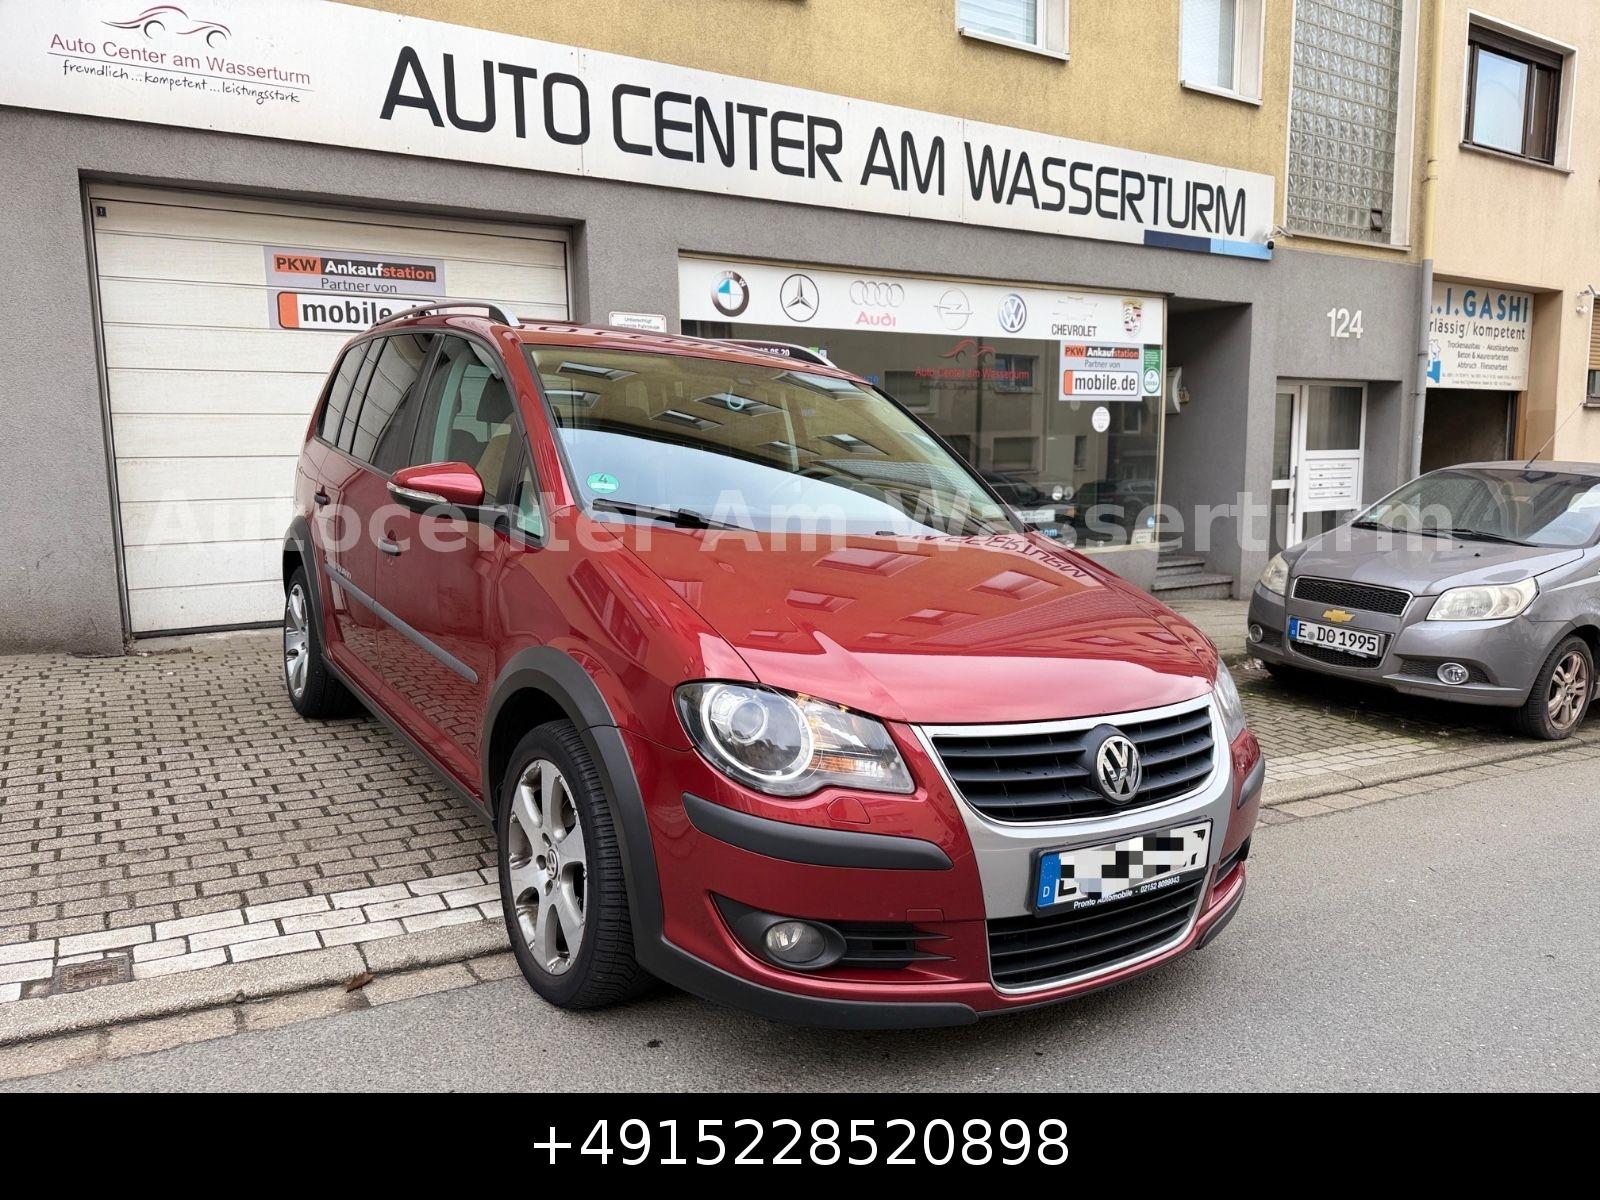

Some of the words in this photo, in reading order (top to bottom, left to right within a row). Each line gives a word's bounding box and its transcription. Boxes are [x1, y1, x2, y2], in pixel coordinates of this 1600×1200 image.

[51, 33, 96, 54] Auto
[103, 41, 167, 65] Center
[173, 53, 200, 69] am
[206, 56, 311, 85] Wasserturm
[379, 45, 590, 146] AUTO
[612, 83, 843, 183] CENTER
[860, 126, 945, 197] AM
[964, 141, 1246, 237] WASSERTURM
[276, 257, 317, 272] PKW
[324, 261, 435, 280] Ankaufstation
[321, 278, 370, 292] Partner
[374, 284, 397, 293] von
[856, 311, 896, 327] Audi
[1326, 307, 1364, 339] 124
[1051, 323, 1097, 337] CHEVROLET
[1473, 321, 1525, 340] kompetent
[1065, 346, 1084, 356] PKW
[1087, 347, 1139, 358] Ankaufstation
[1084, 359, 1107, 368] Partner
[1075, 374, 1136, 391] mobile.de
[599, 473, 608, 483] 4
[1299, 623, 1307, 638] E
[1339, 632, 1376, 651] 1995
[1043, 886, 1050, 898] D
[1073, 899, 1096, 910] Pronto
